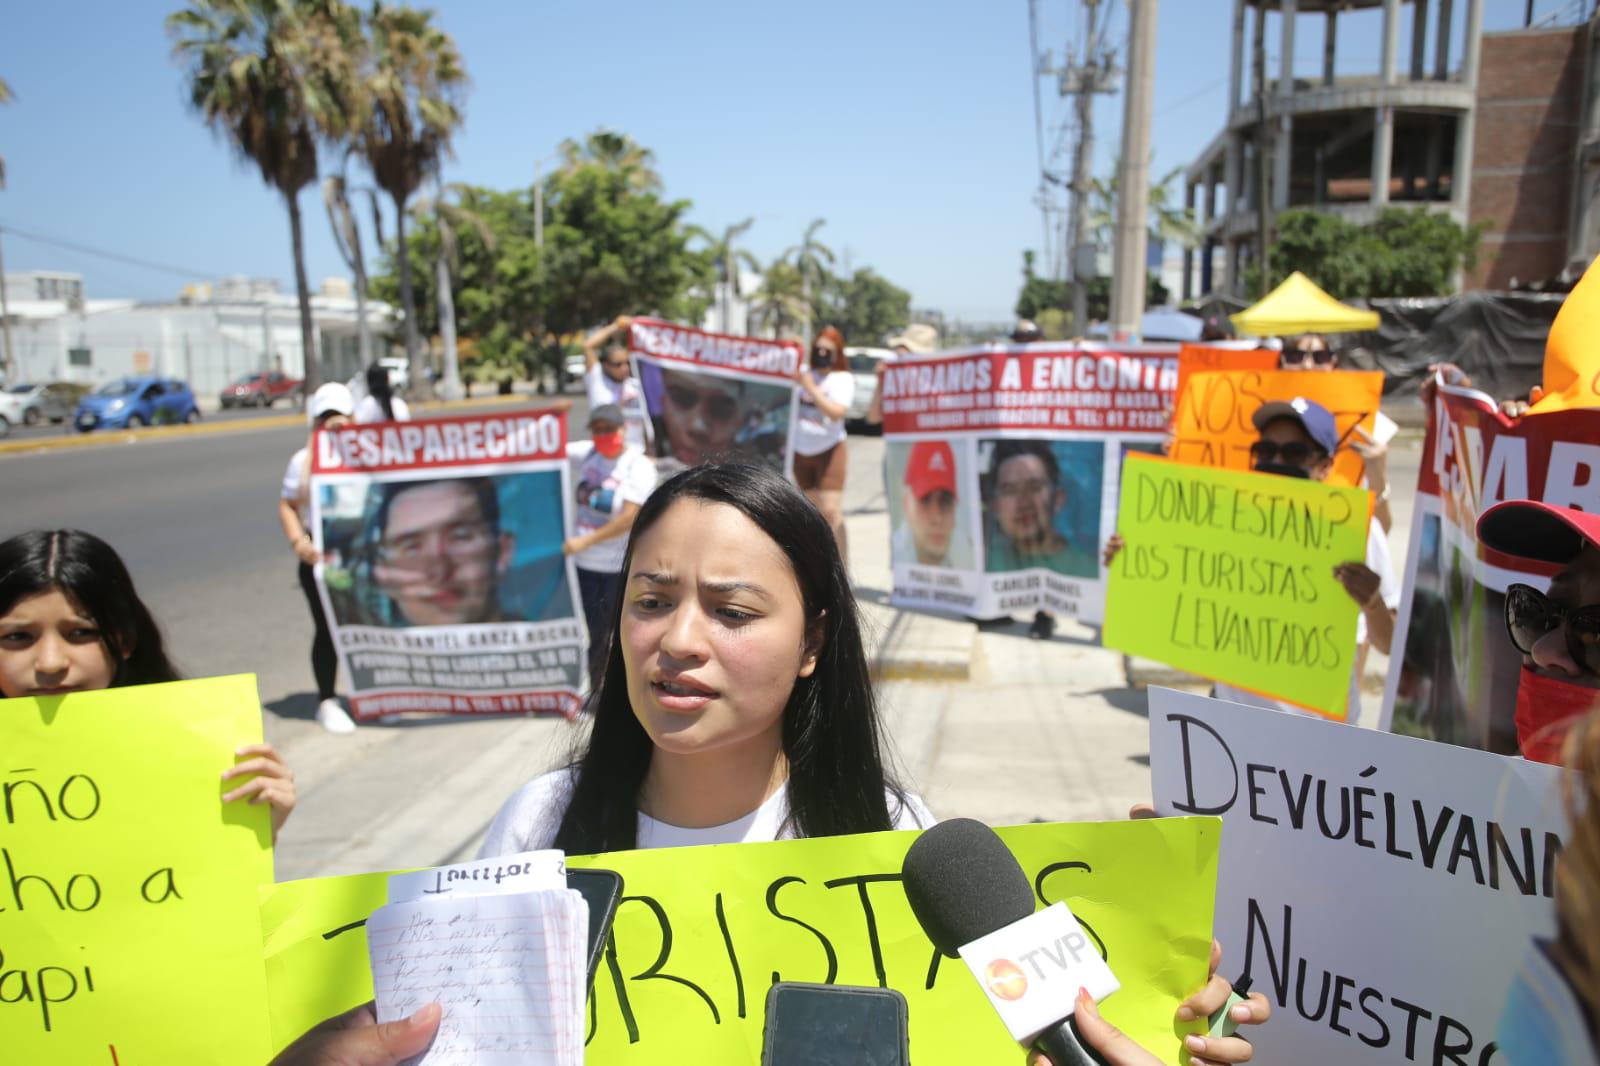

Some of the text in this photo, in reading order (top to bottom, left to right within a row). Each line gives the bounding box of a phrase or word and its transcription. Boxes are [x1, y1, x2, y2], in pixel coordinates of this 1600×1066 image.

[630, 323, 800, 376] DESAPARECIDO
[1000, 357, 1022, 390] A
[317, 413, 560, 469] DESAPARECIDO
[1137, 471, 1226, 530] DONDE
[1120, 543, 1319, 604] LOS TURISTAS
[1170, 592, 1341, 672] LEVANTADOS
[0, 847, 184, 913] ho a
[1018, 931, 1086, 981] TVP
[0, 945, 95, 1032] api
